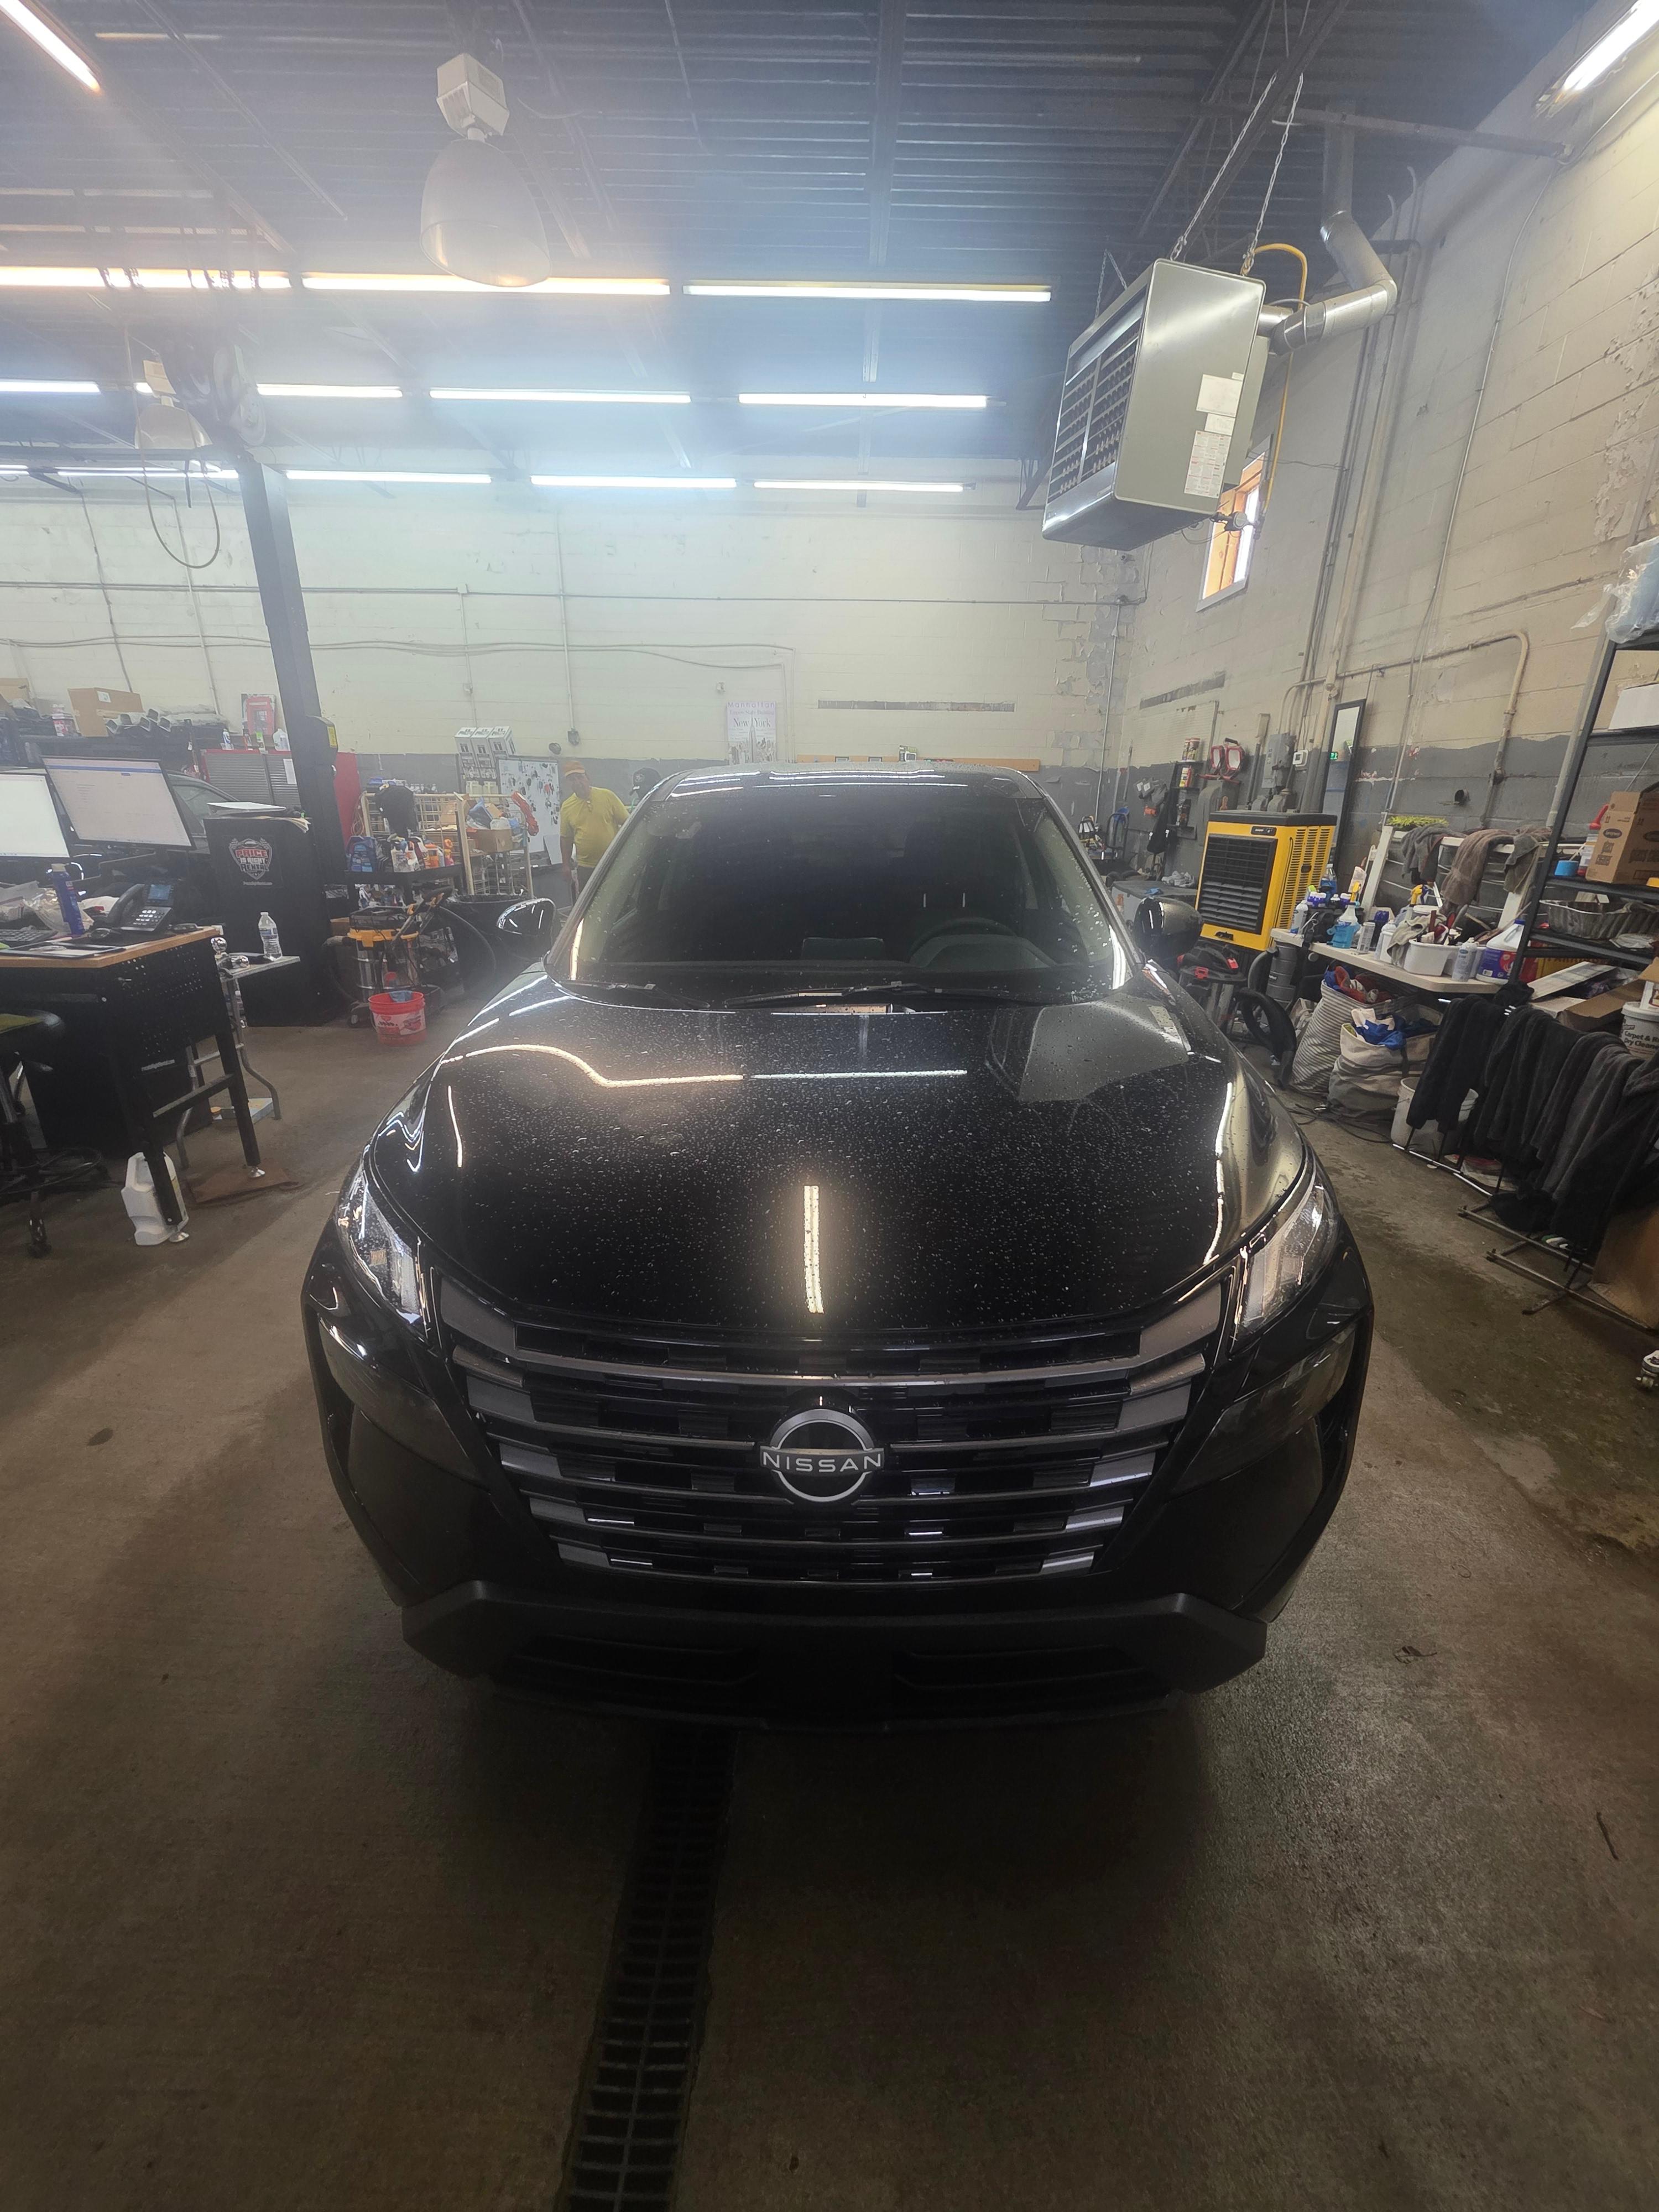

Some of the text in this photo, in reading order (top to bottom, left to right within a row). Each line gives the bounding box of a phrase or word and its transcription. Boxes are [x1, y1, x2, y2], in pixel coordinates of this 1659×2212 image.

[733, 718, 770, 727] New York
[235, 849, 268, 858] PRICE
[1625, 1031, 1644, 1040] Carpet
[1624, 1037, 1634, 1046] Dry
[763, 1452, 881, 1472] NISSAN
